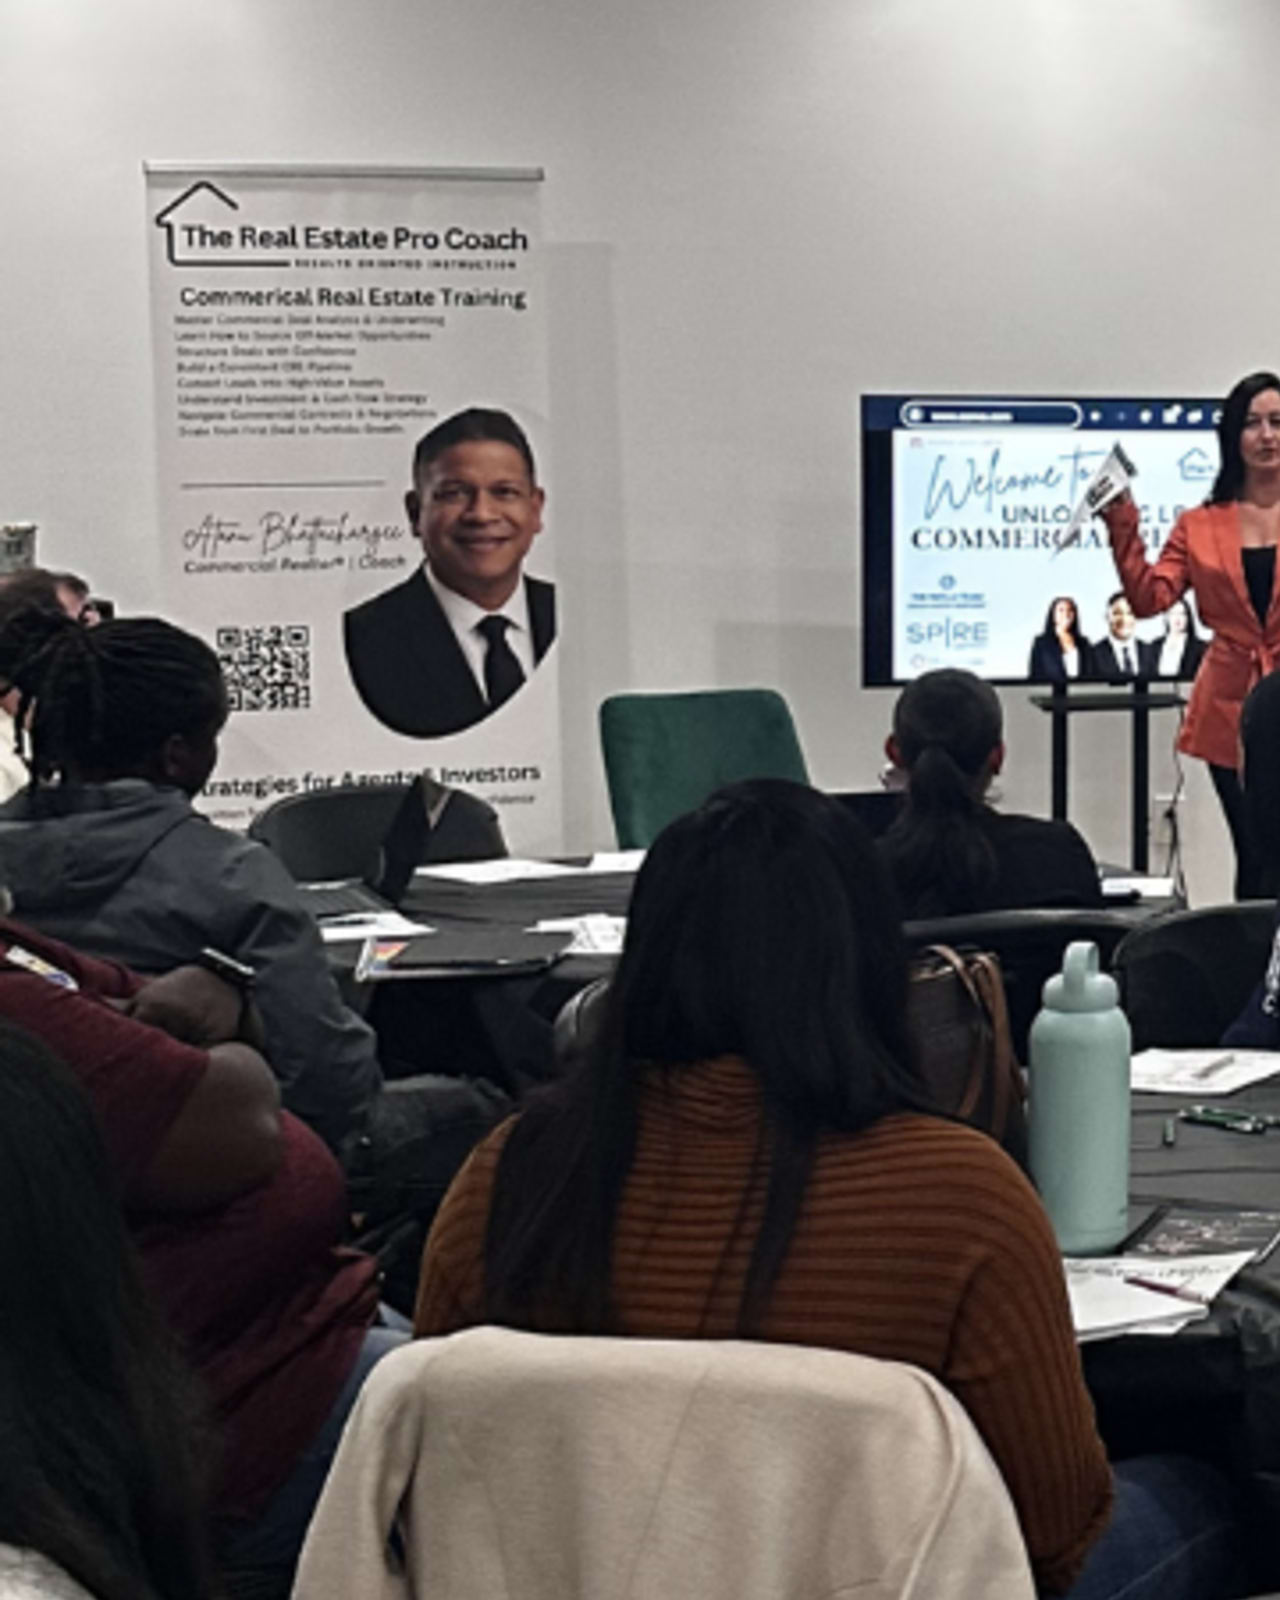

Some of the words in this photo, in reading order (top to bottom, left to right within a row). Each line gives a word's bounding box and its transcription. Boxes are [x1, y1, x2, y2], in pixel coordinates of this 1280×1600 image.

[182, 224, 233, 248] The
[240, 225, 299, 248] Real
[304, 226, 388, 249] Estate
[394, 227, 439, 249] Pro
[445, 227, 528, 250] Coach
[317, 288, 364, 306] Real
[369, 288, 435, 306] Estate
[440, 288, 527, 310] Training
[924, 446, 1065, 521] Welcome
[201, 776, 298, 799] trategies
[303, 773, 334, 794] for
[440, 765, 541, 784] Investors
